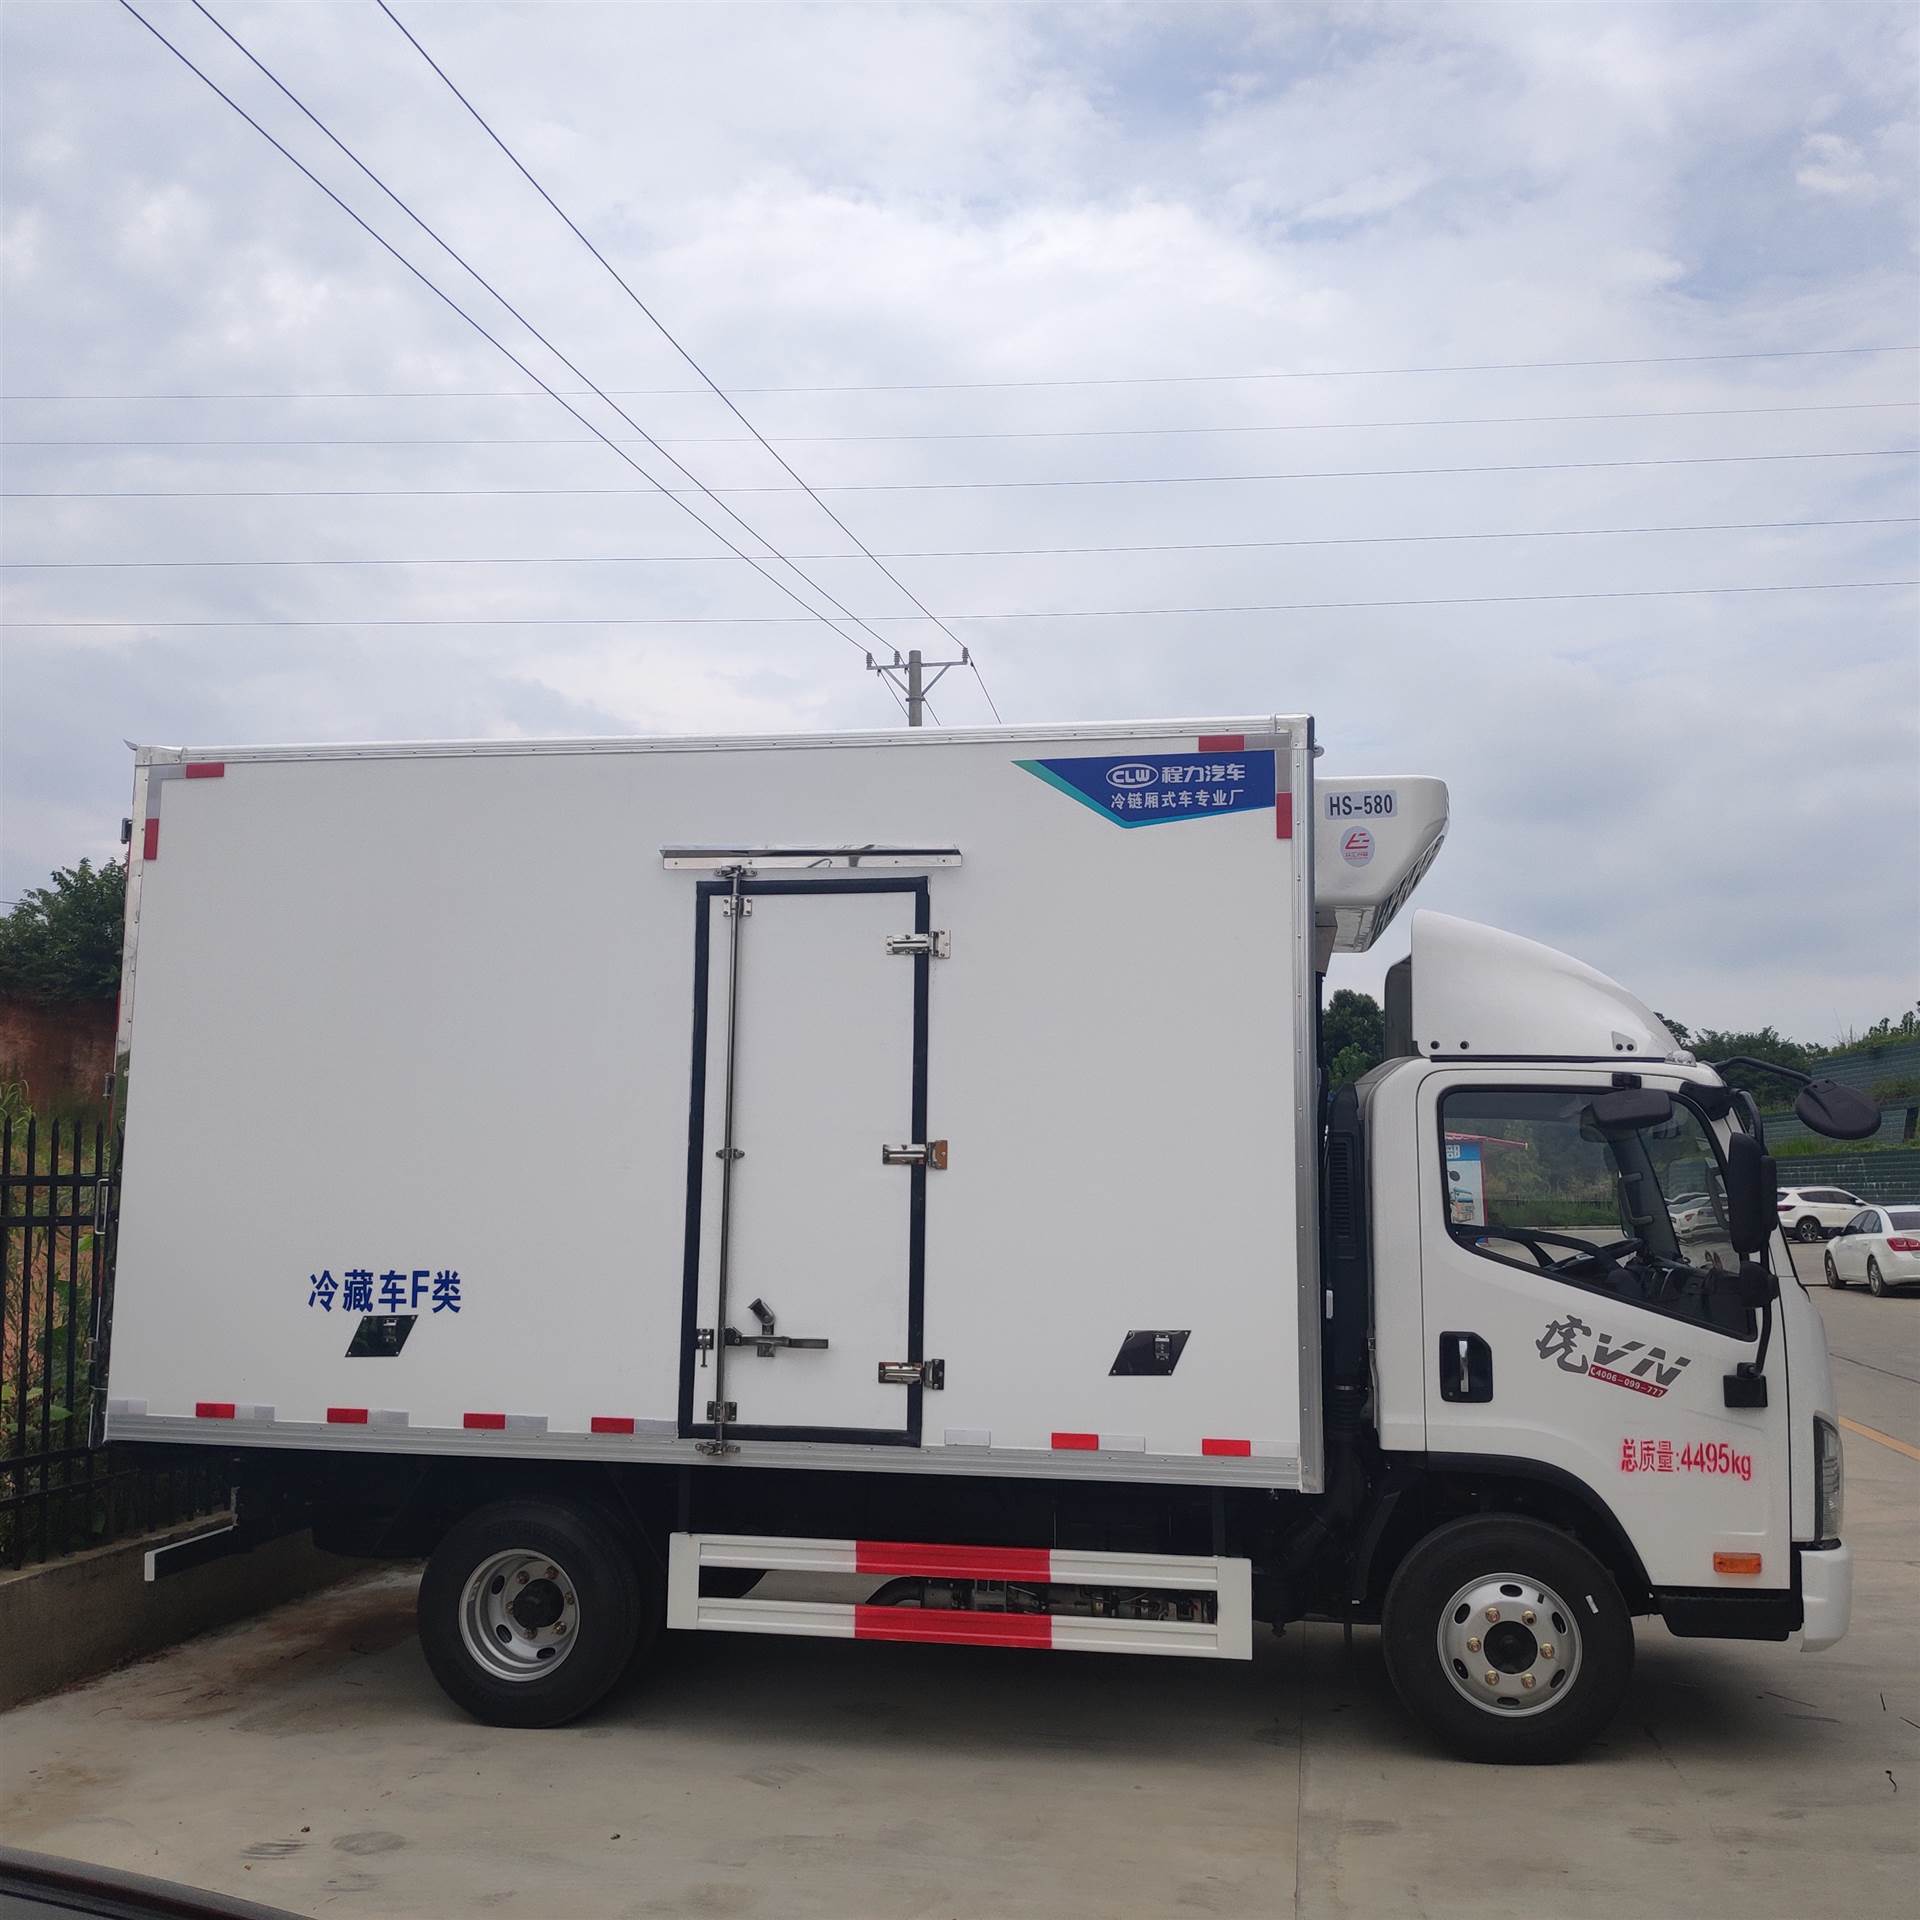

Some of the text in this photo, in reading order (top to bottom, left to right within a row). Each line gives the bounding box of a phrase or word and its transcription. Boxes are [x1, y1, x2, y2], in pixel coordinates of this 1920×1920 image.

[1112, 764, 1246, 784] CLW 程力汽车
[1110, 789, 1245, 810] 冷链厢式车专业厂
[1329, 794, 1393, 816] HS-580
[308, 1269, 462, 1314] 冷藏车F类
